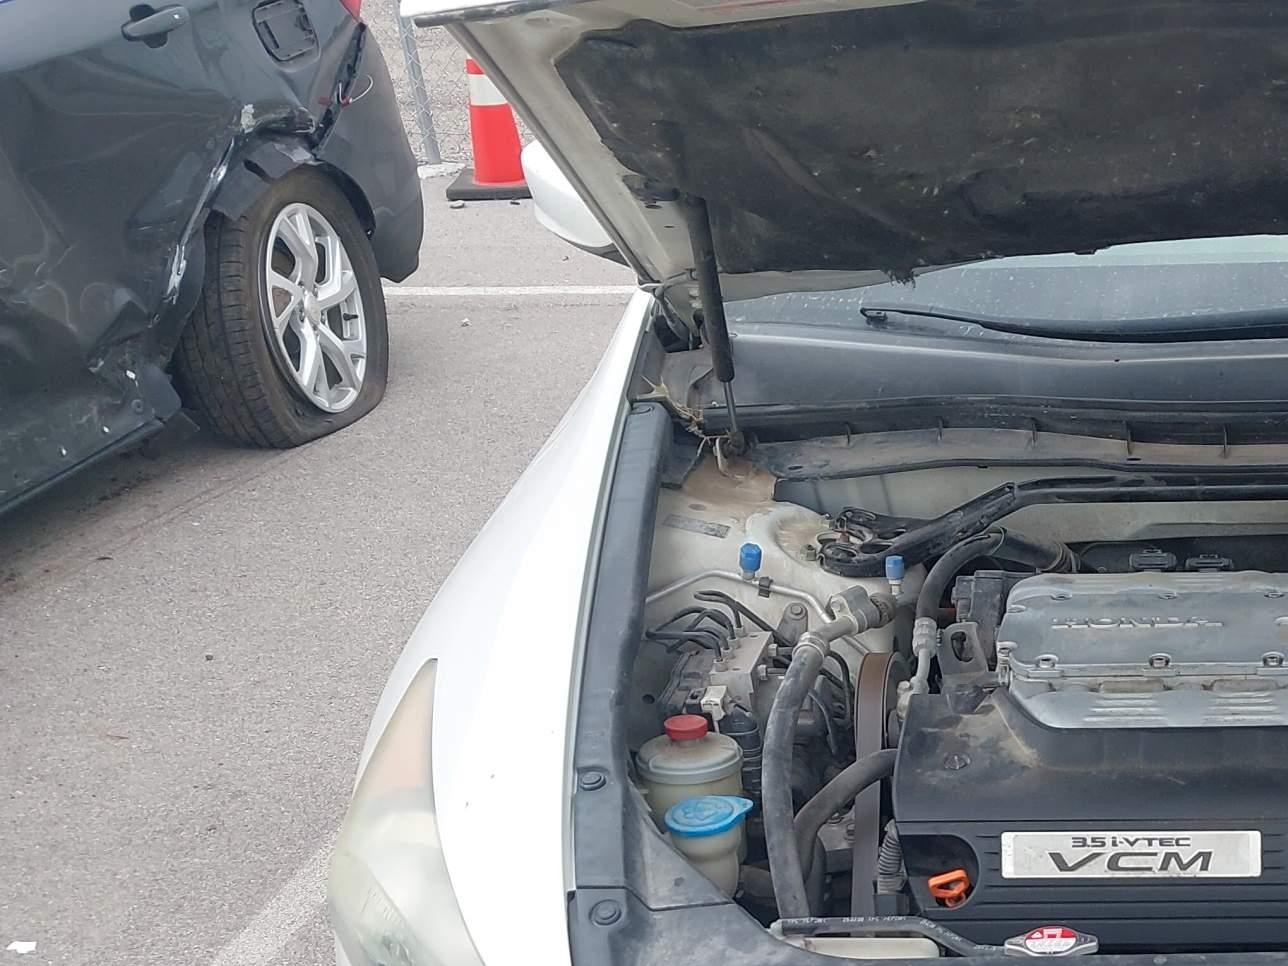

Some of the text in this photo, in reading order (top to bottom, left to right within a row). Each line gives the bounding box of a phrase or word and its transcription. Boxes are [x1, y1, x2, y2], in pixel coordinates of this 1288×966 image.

[1071, 836, 1192, 848] 3.5 i-VTEC
[1048, 851, 1214, 873] VCM
